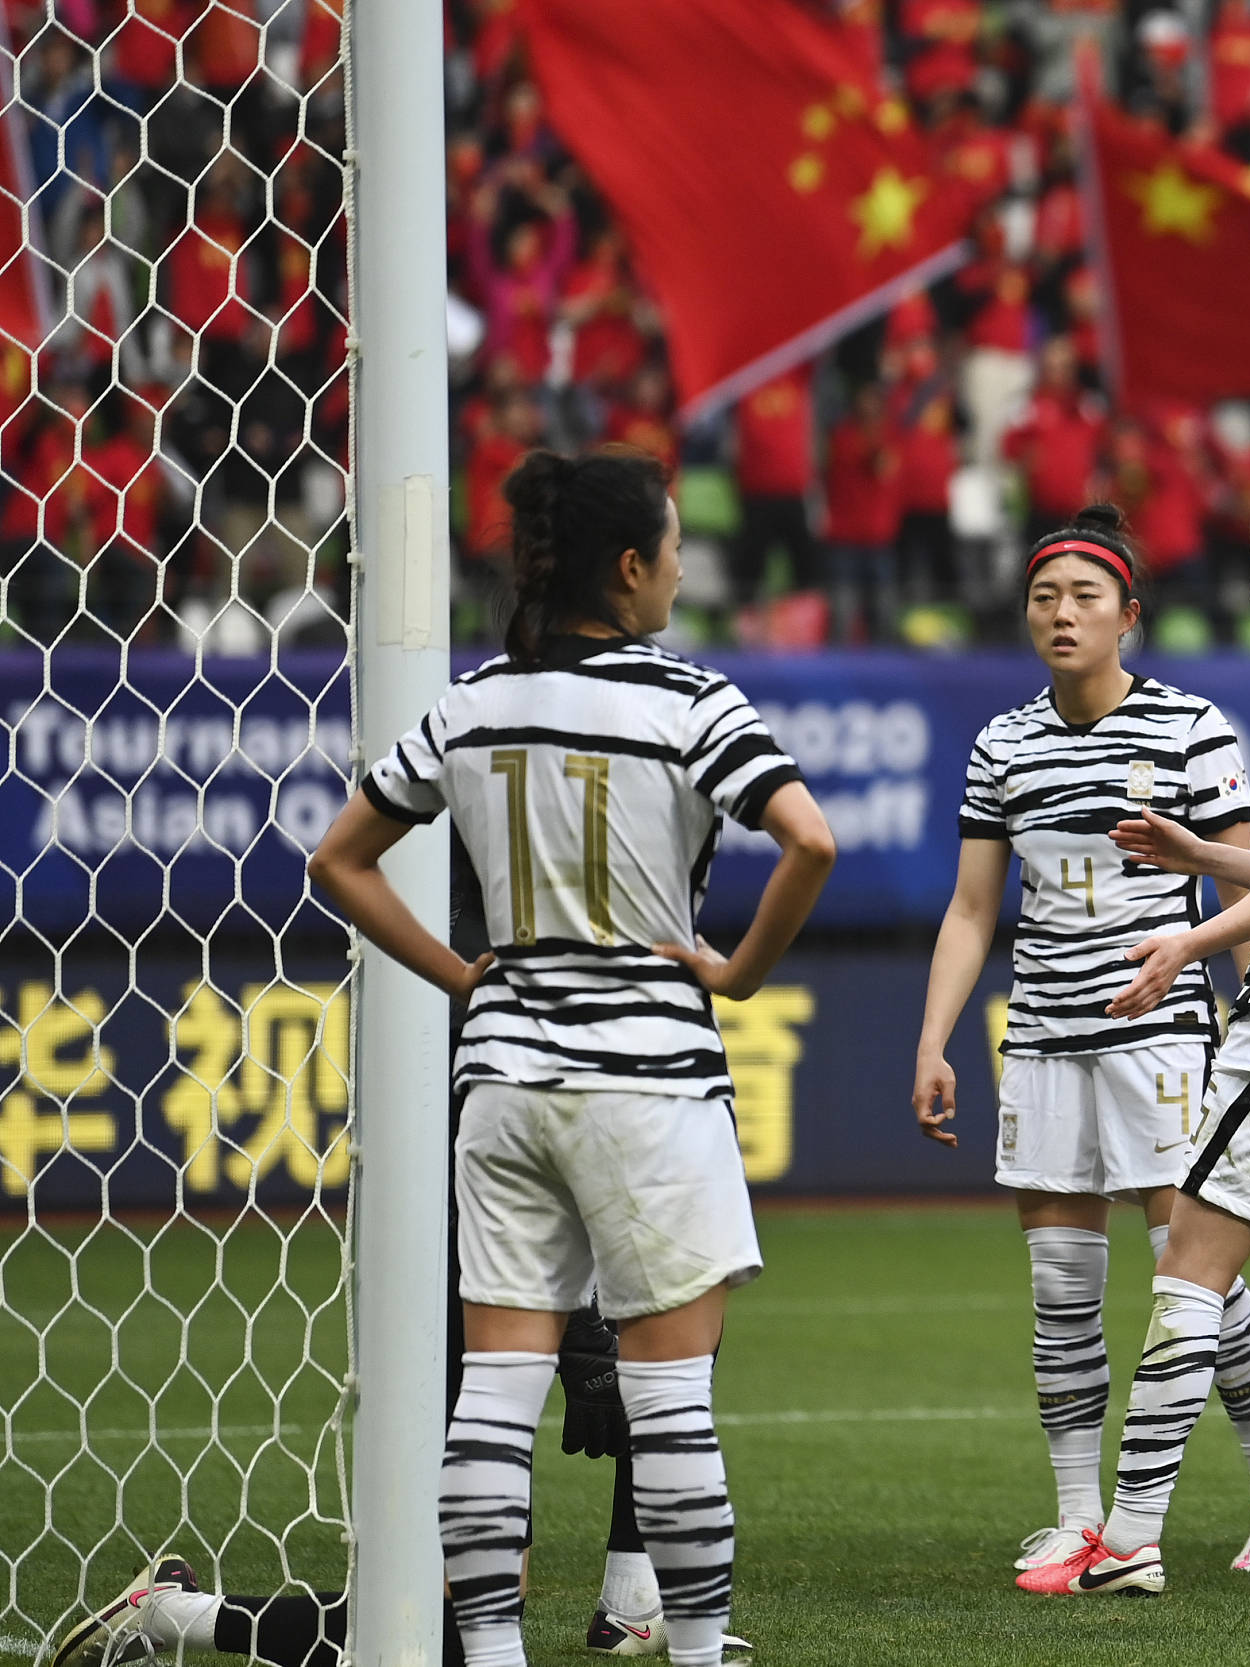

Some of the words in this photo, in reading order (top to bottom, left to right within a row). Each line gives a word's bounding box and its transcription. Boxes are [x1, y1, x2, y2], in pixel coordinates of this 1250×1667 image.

[32, 784, 257, 853] Asian
[490, 749, 614, 946] 11
[1060, 857, 1095, 917] 4
[1156, 1072, 1189, 1134] 4
